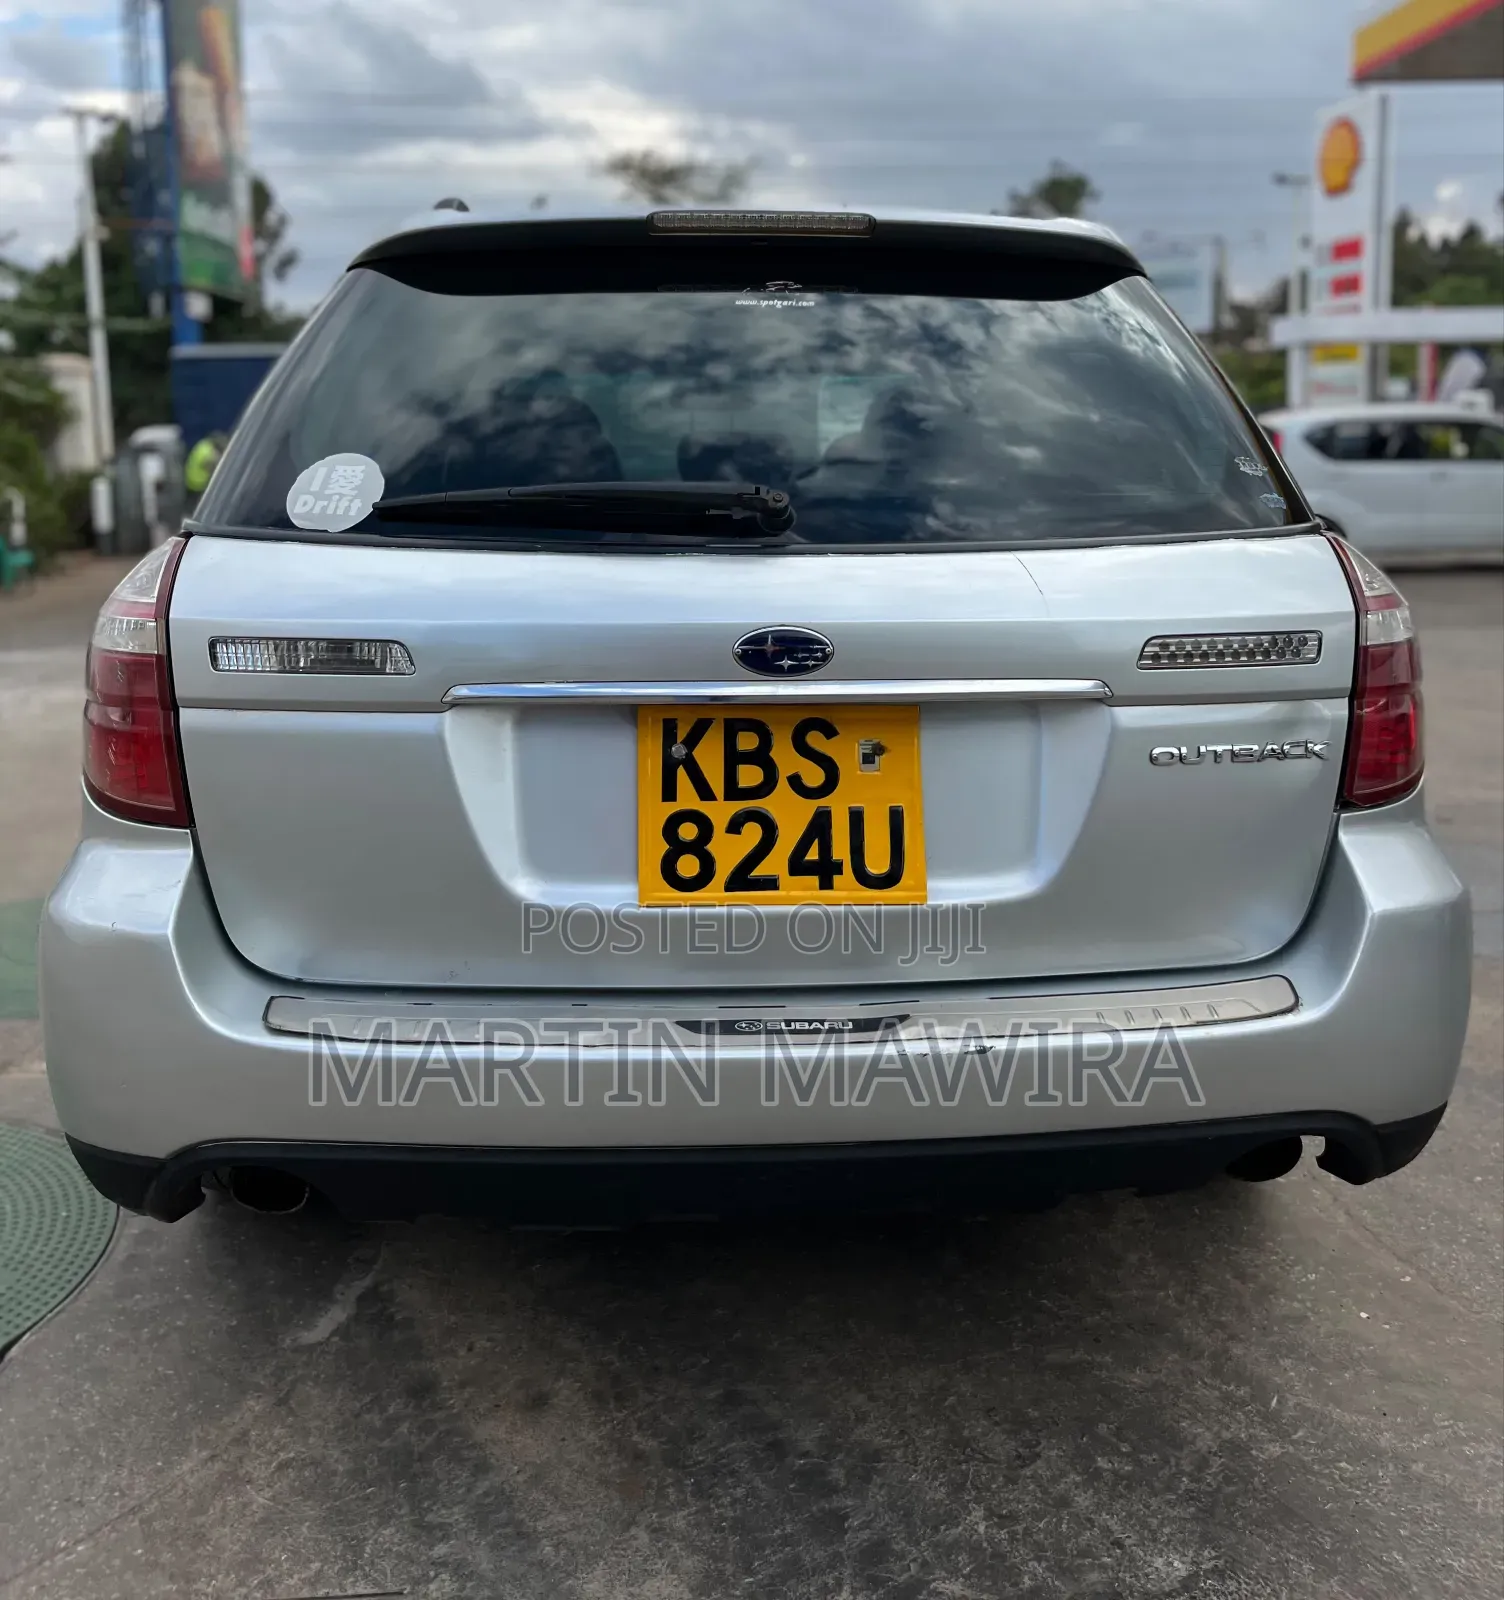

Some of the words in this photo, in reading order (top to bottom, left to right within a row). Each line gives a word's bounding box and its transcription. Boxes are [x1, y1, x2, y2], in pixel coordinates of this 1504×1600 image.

[293, 494, 363, 516] Drift
[661, 717, 841, 802] KBS
[1149, 739, 1332, 767] OUTBACK
[660, 805, 906, 893] 824U
[766, 1021, 853, 1030] SUBARU
